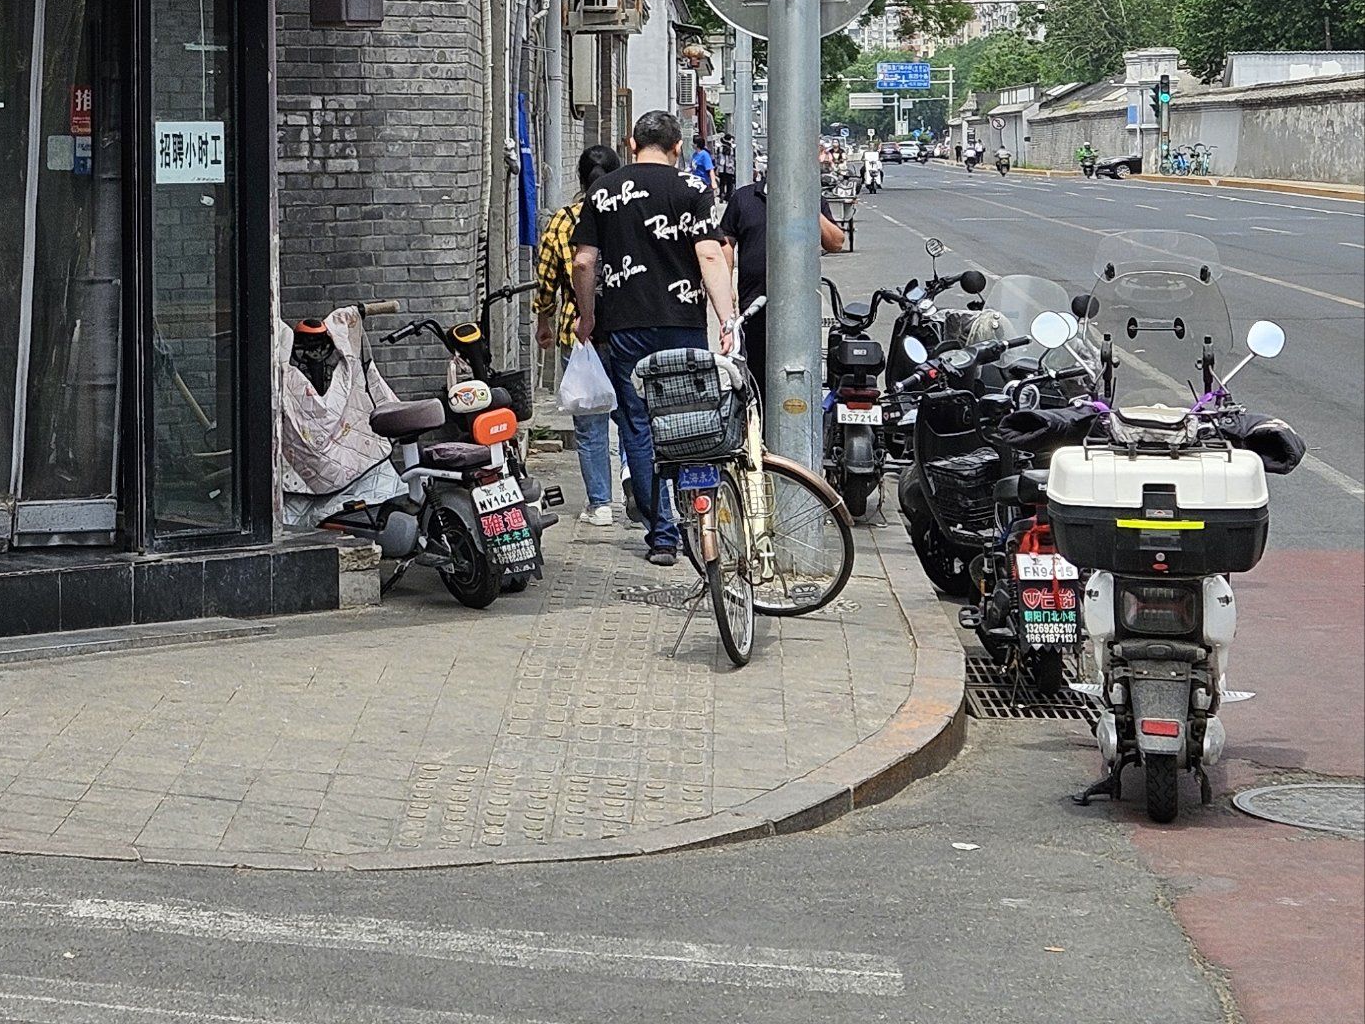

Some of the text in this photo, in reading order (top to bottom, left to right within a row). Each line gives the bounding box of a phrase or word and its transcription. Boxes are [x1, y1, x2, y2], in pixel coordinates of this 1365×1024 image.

[160, 132, 222, 169] 招聘小时工
[840, 413, 879, 424] BS7214
[478, 489, 520, 512] NV1421
[481, 508, 526, 537] 雅迪
[1024, 610, 1076, 622] 朝阳门北小街
[1024, 622, 1077, 634] 13269262107
[1025, 633, 1077, 644] 18611871131
